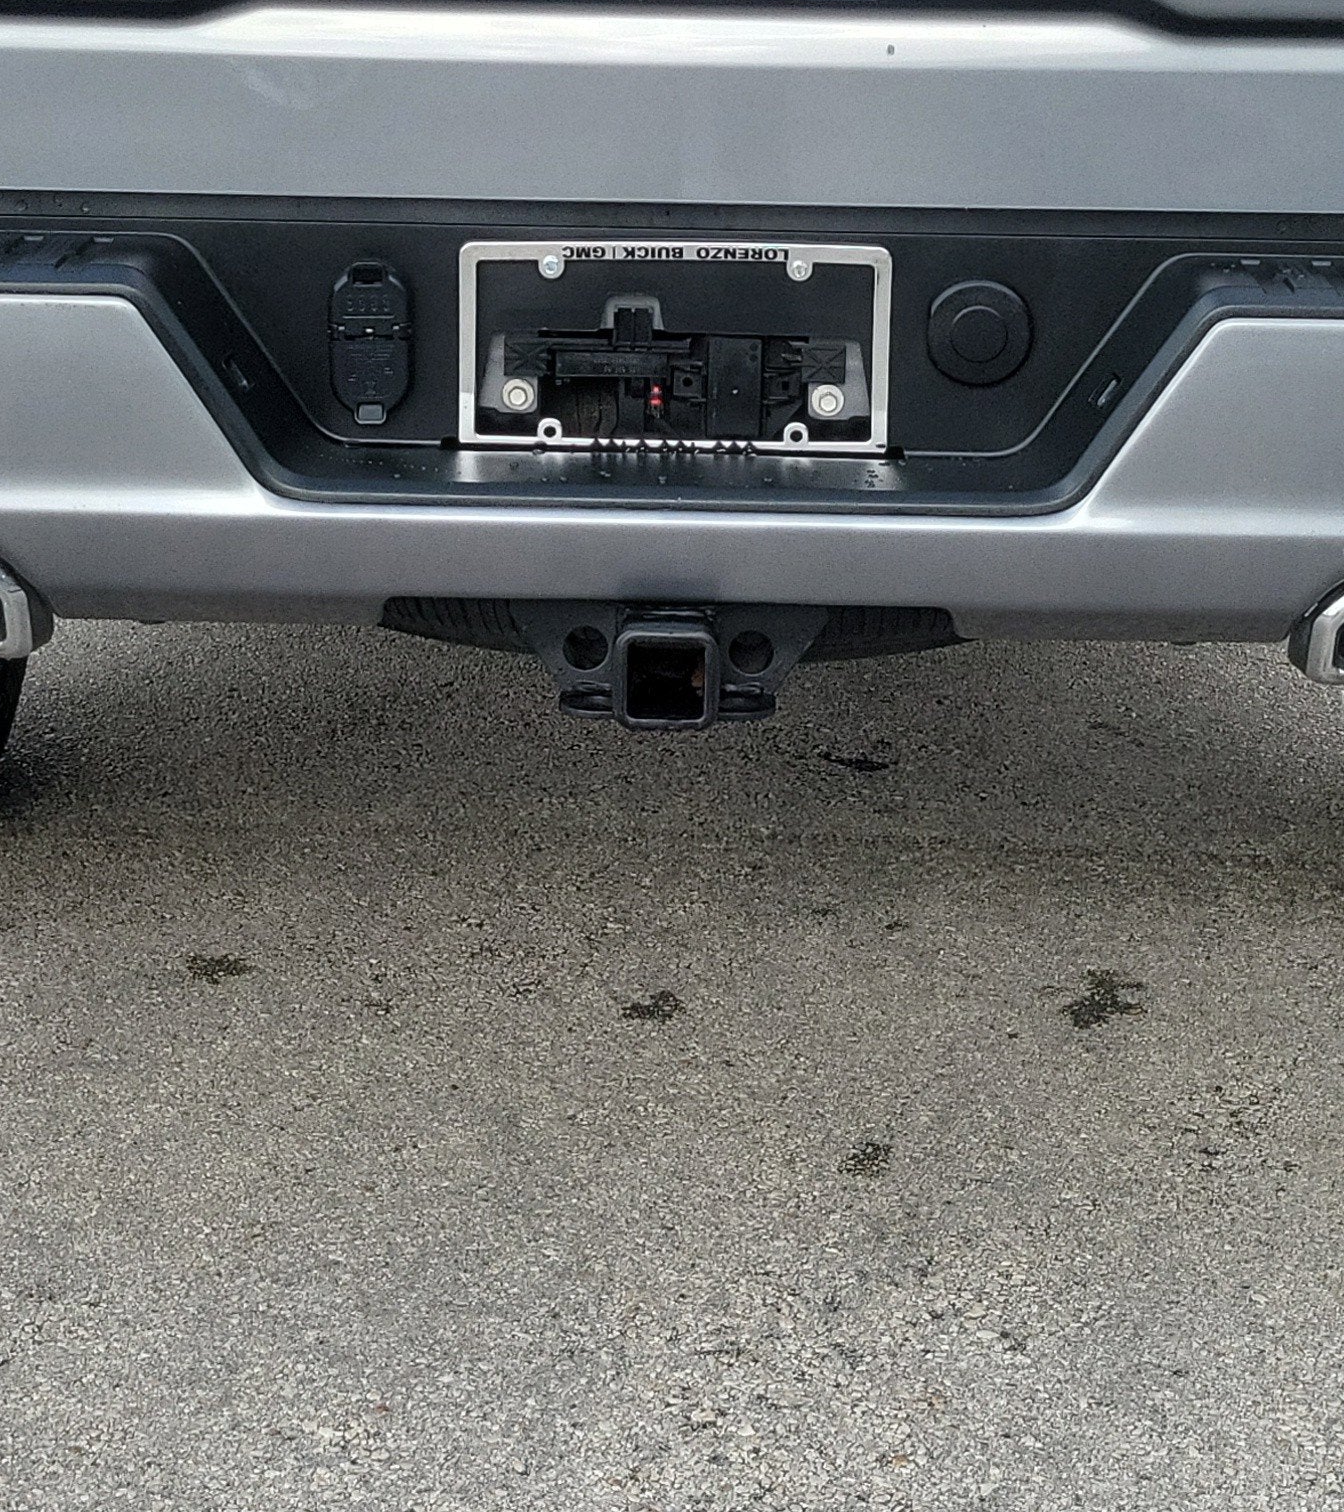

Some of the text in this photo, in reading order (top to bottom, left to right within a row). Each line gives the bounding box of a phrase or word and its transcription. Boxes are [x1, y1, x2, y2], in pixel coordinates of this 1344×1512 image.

[561, 245, 790, 262] LORENZO BUICK GMC
